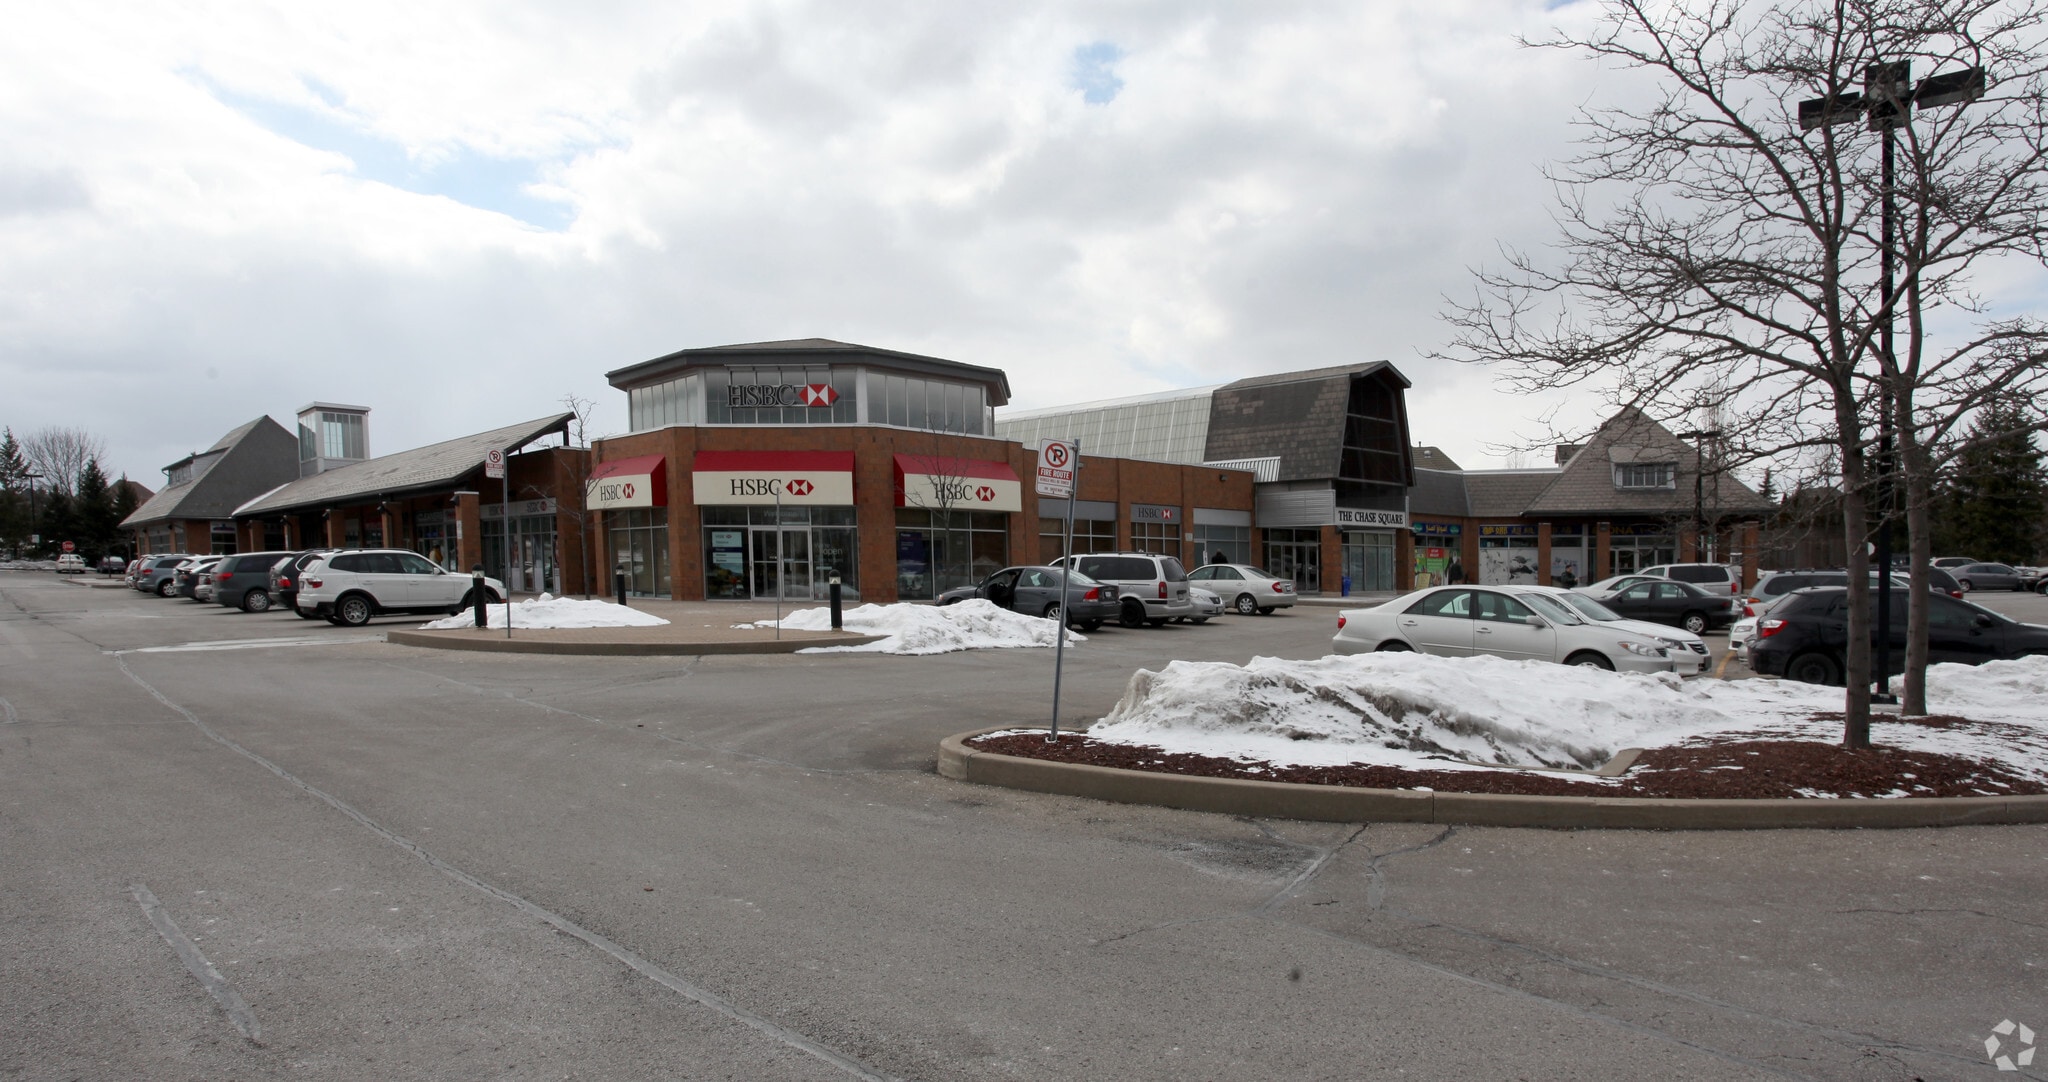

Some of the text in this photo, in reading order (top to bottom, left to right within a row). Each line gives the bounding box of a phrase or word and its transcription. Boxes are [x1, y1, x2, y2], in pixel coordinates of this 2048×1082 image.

[727, 384, 795, 407] HSBC
[1040, 468, 1070, 479] FIRE ROUTE
[600, 483, 622, 501] HSBC
[730, 478, 782, 496] HSBC
[935, 483, 973, 501] HSBC
[1138, 507, 1160, 519] HSBC
[1338, 510, 1403, 525] THE CHASE SQUARE
